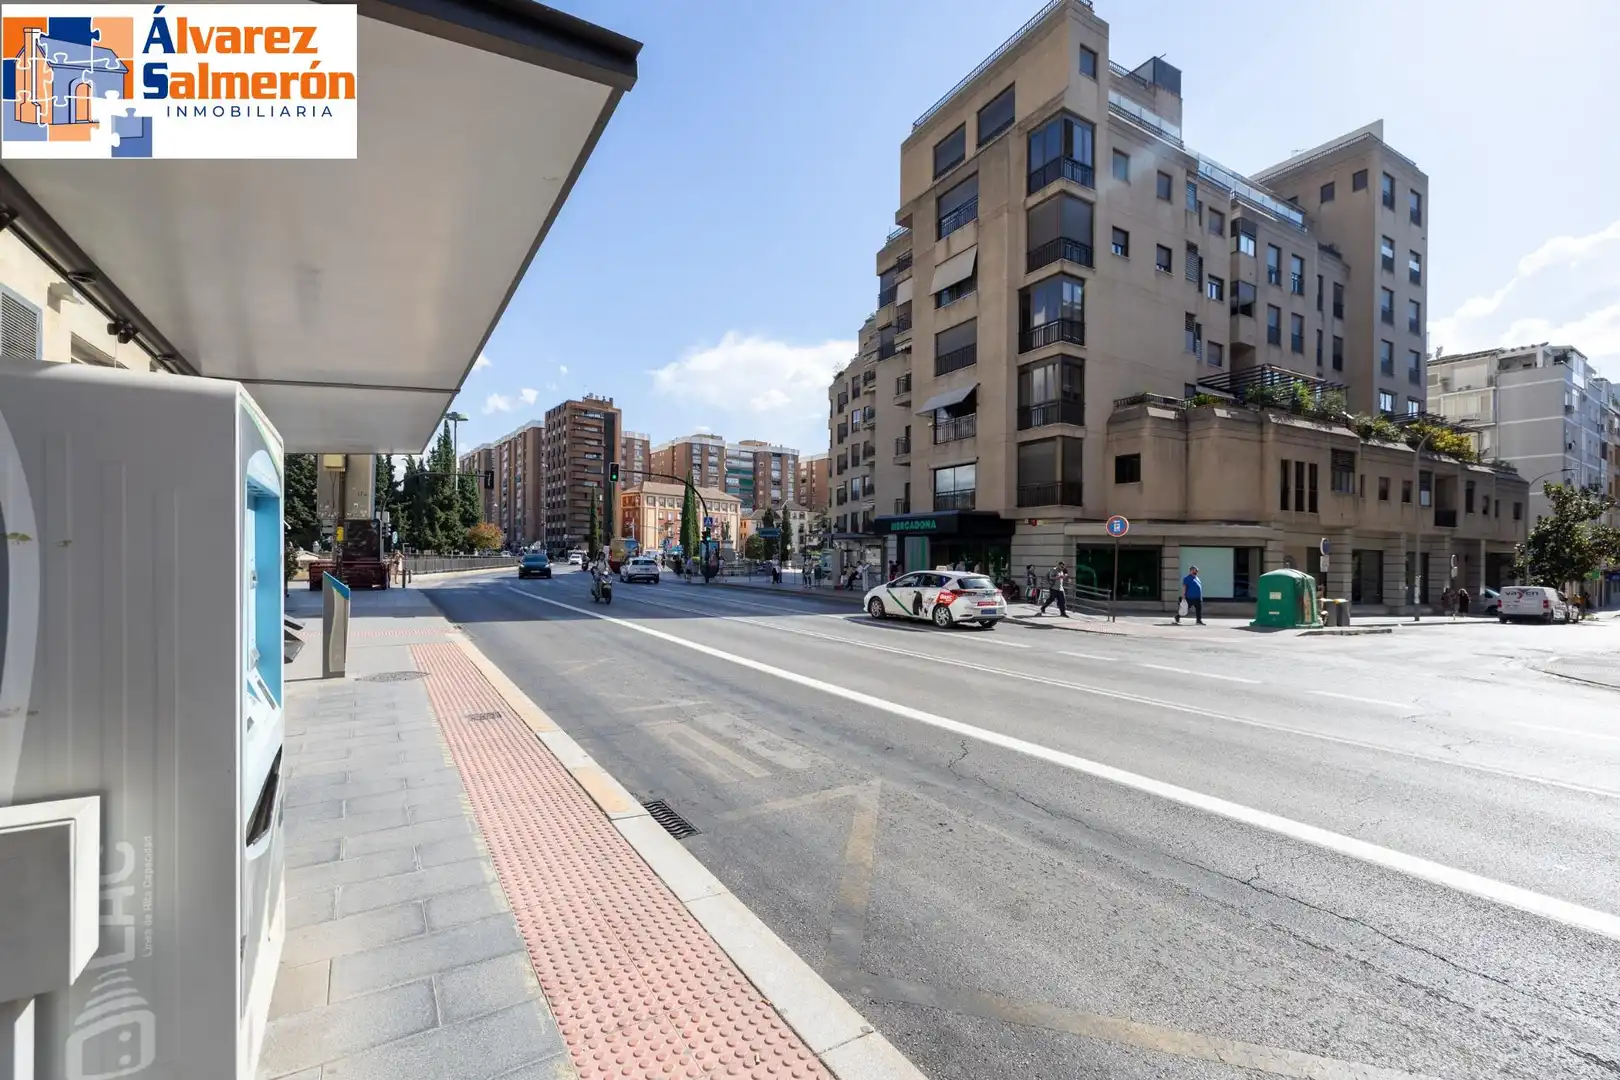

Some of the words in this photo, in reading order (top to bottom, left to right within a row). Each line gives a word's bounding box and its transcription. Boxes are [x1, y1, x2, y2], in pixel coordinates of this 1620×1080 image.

[891, 519, 936, 530] MERCADONA
[142, 835, 154, 888] Capacidad
[142, 912, 153, 926] de
